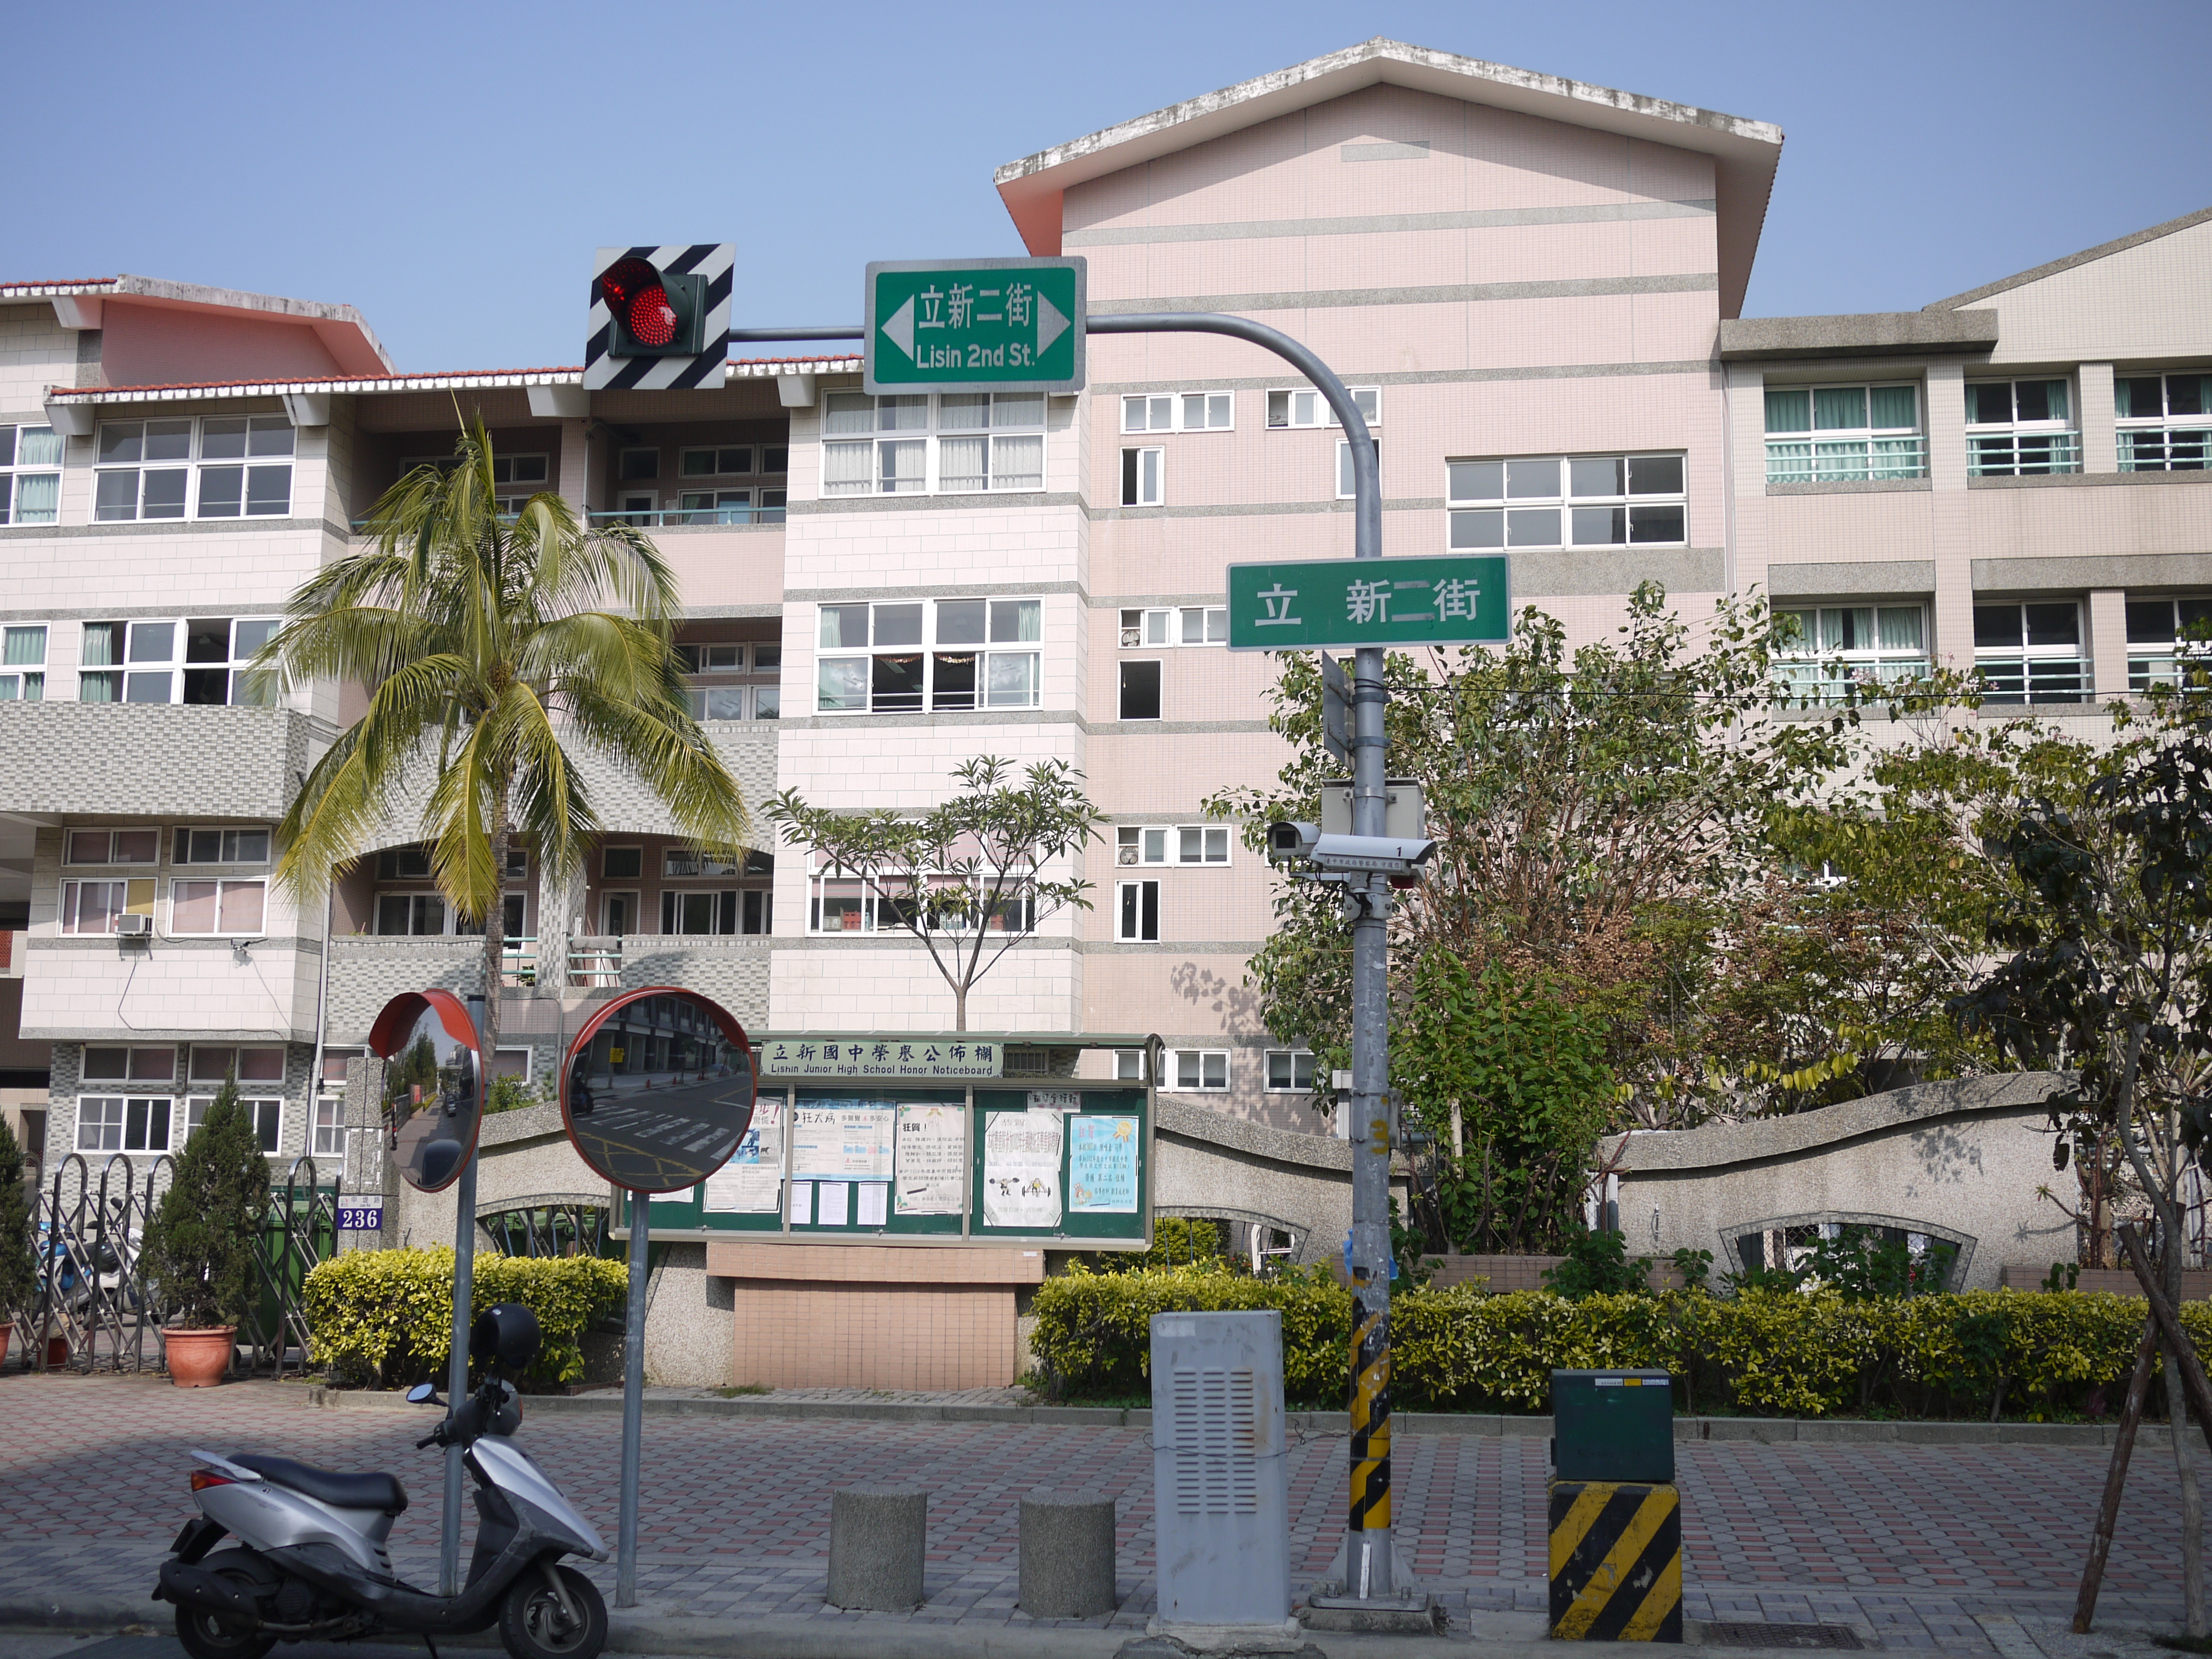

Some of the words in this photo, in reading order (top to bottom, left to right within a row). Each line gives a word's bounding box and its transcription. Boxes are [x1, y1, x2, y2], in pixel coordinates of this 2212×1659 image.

[919, 282, 1032, 329] 立新二街
[917, 344, 962, 368] Lisin
[967, 343, 1004, 368] 2nd
[1009, 342, 1035, 367] St.
[1255, 578, 1480, 627] 立新二街
[1397, 846, 1402, 857] 1
[773, 1044, 993, 1062] 立新國中榮譽公佈欄
[771, 1064, 799, 1073] Lishin
[804, 1065, 832, 1074] Junior
[838, 1064, 858, 1075] High
[863, 1065, 895, 1074] School
[900, 1065, 927, 1074] Honor
[933, 1065, 993, 1075] Noticeboard
[802, 1110, 836, 1125] 狂犬病
[342, 1210, 377, 1228] 236
